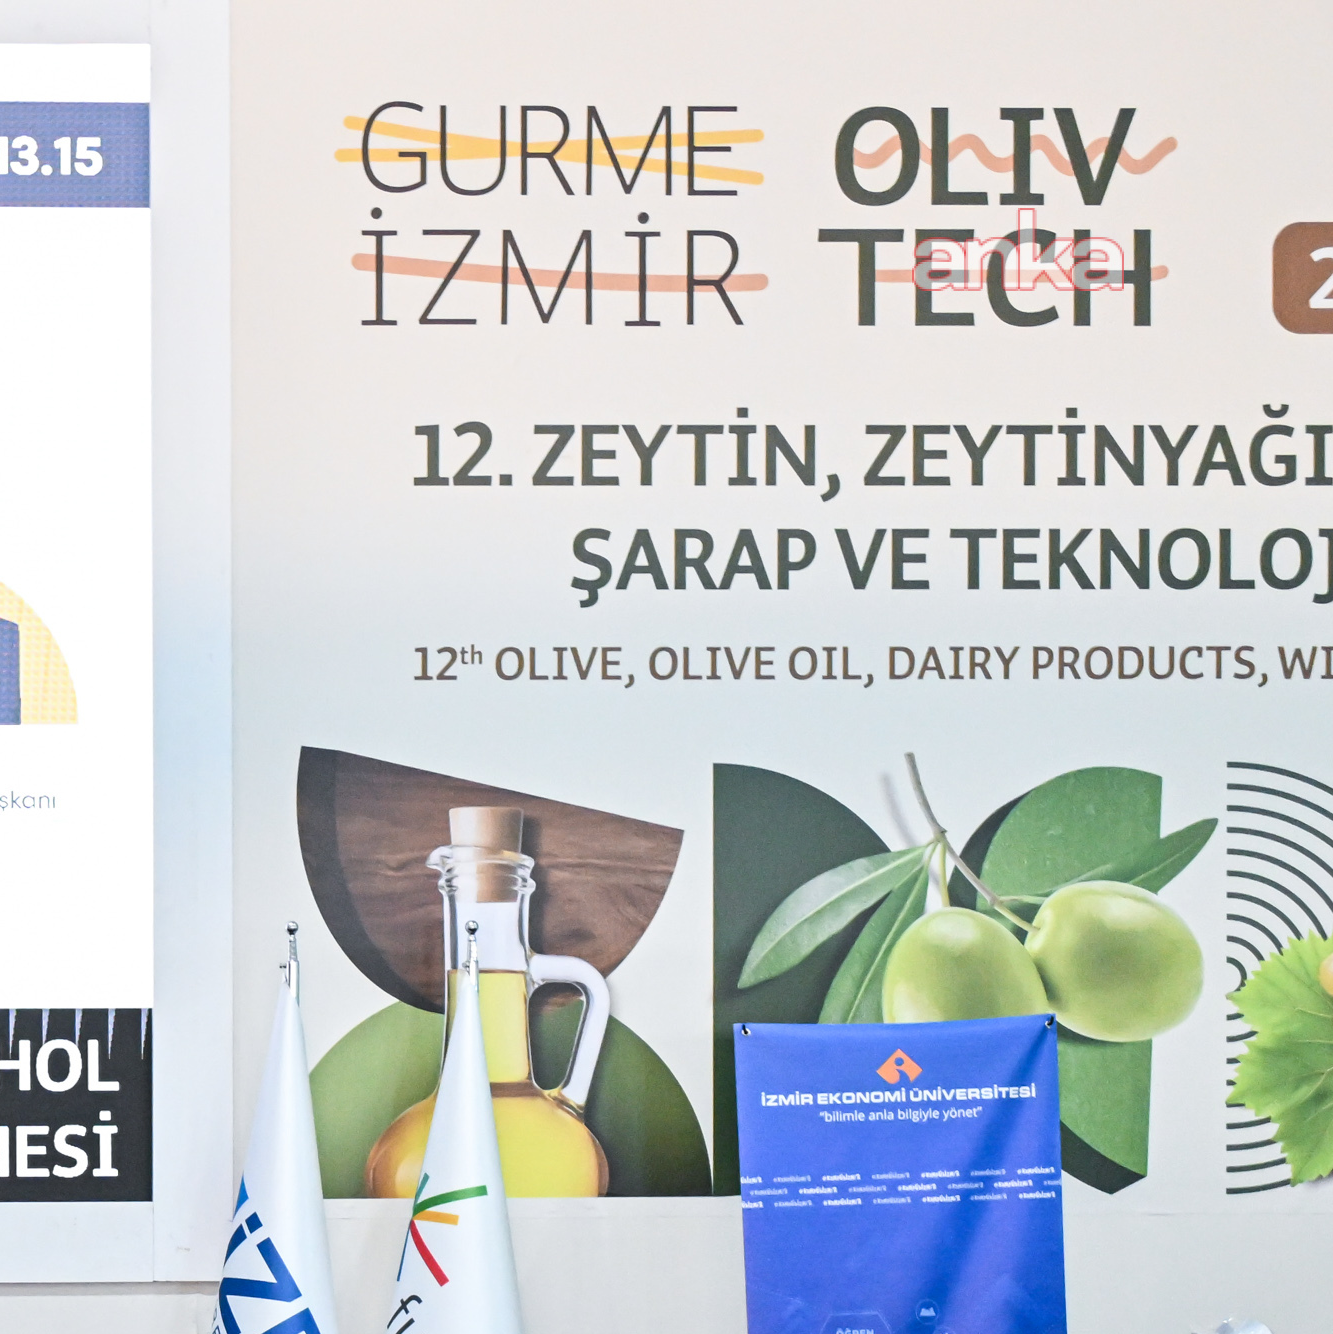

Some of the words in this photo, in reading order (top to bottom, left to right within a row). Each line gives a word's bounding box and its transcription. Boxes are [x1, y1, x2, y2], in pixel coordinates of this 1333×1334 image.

[360, 100, 738, 197] GURME
[834, 105, 1136, 206] OLIV
[360, 207, 744, 327] İZMİR
[818, 228, 1153, 328] TECH
[412, 420, 513, 487] 12.
[531, 408, 841, 502] ZEYTİN,
[571, 528, 816, 608] ŞARAP
[834, 528, 930, 591] VE
[412, 645, 482, 682] 12th
[494, 645, 635, 689] OLIVE,
[649, 645, 775, 682] OLIVE
[787, 645, 875, 689] OIL,
[888, 645, 1019, 682] DAIRY
[1031, 645, 1268, 689] PRODUCTS,
[761, 1091, 813, 1107] İZMİR
[817, 1087, 906, 1105] EKONOMİ
[910, 1083, 1036, 1102] ÜNİVERSİTESİ
[868, 1109, 894, 1120] anla
[898, 1107, 939, 1123] bilgiyle
